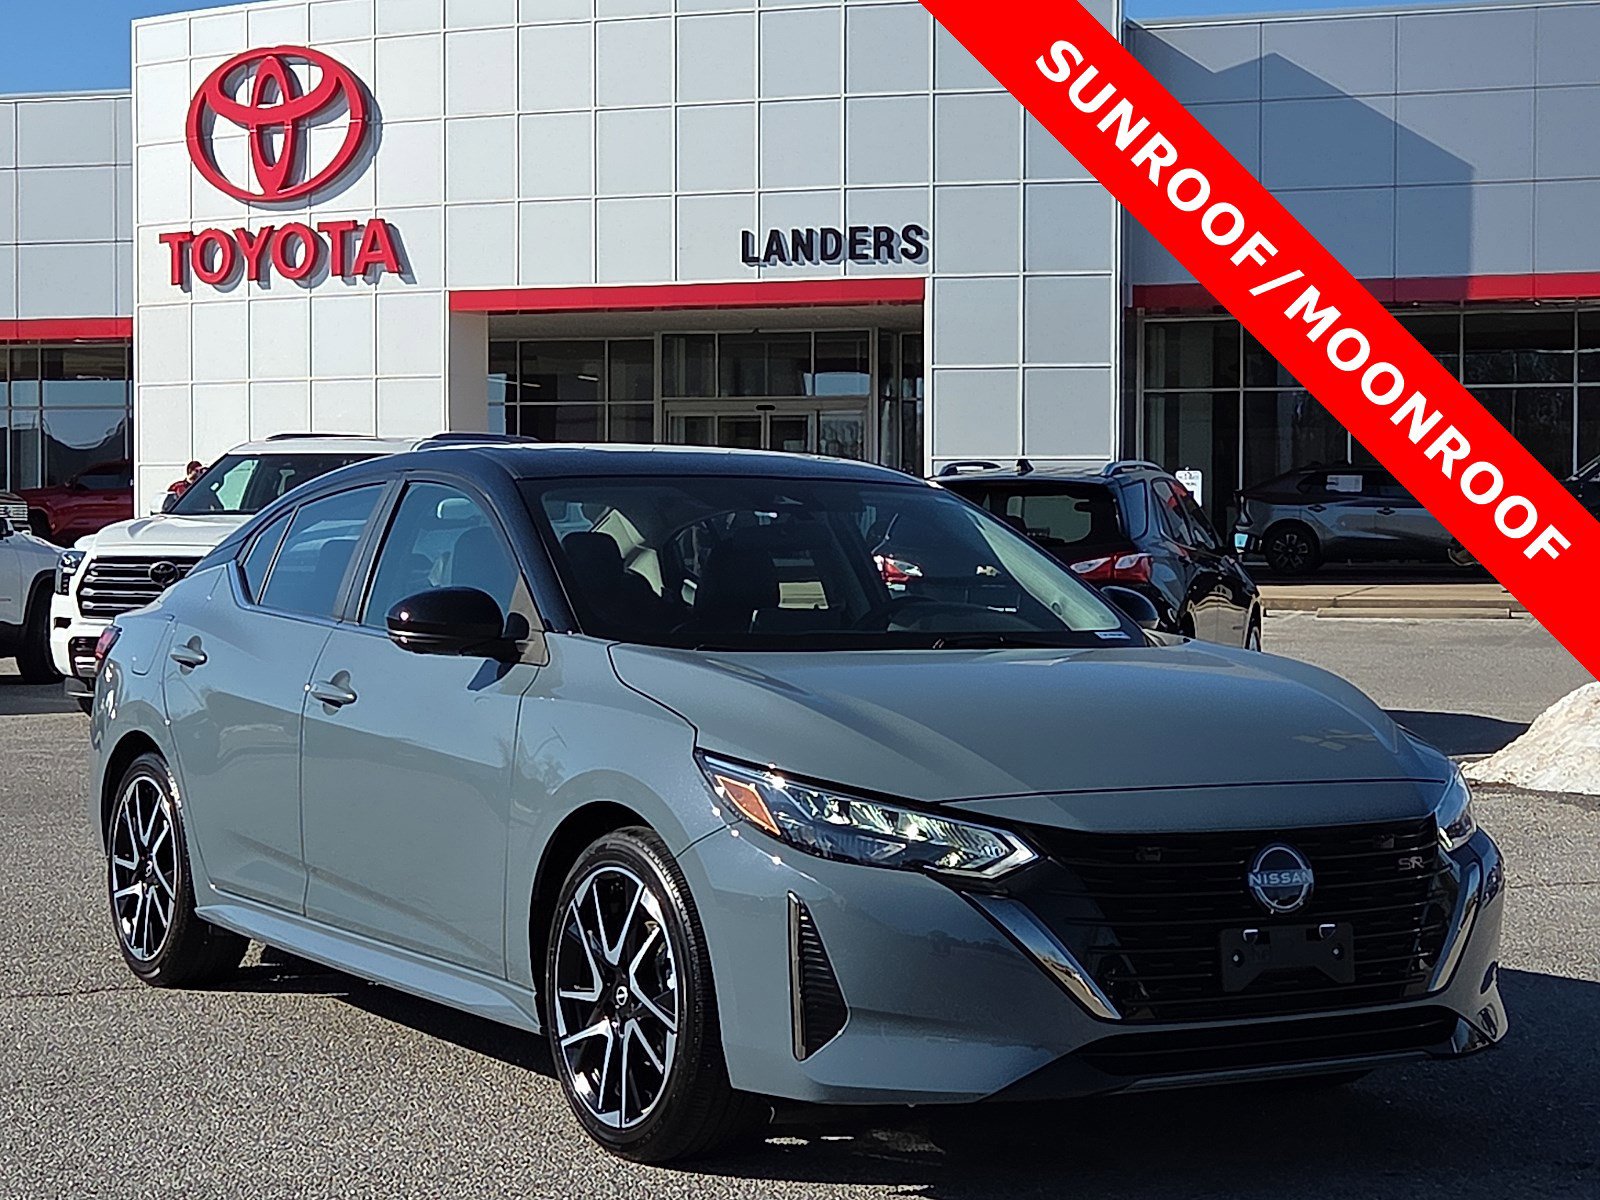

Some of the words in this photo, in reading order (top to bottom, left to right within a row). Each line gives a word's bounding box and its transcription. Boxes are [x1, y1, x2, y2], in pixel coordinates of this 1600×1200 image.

[159, 218, 403, 286] TOYOTA
[741, 224, 926, 264] LANDERS
[1398, 856, 1424, 870] SR
[1249, 870, 1312, 885] NISSAN
